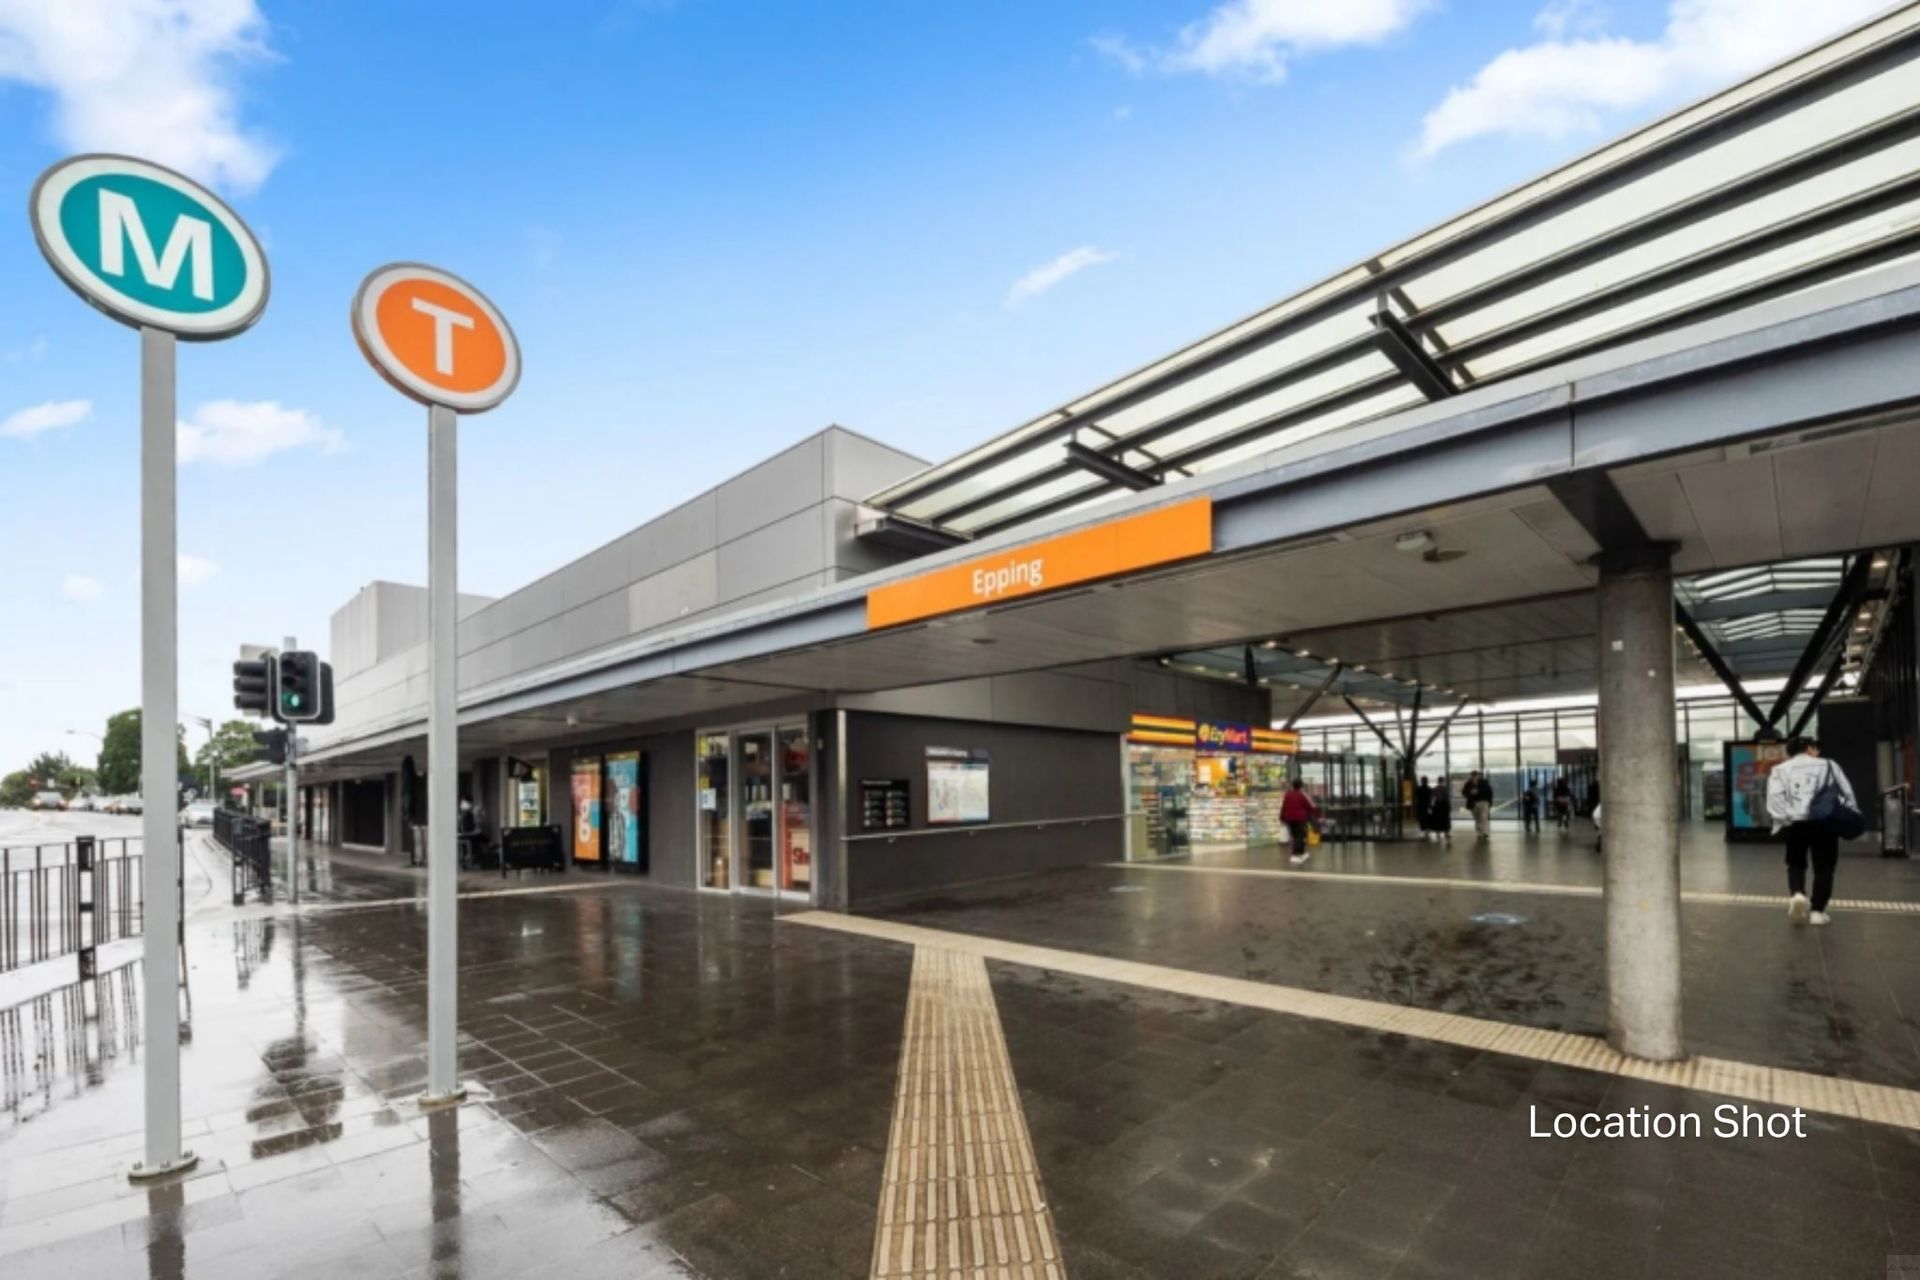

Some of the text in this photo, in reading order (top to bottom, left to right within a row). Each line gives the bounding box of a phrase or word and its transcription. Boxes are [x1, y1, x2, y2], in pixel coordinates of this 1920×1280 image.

[98, 188, 214, 301] M
[412, 297, 475, 377] T
[972, 557, 1044, 597] Epping
